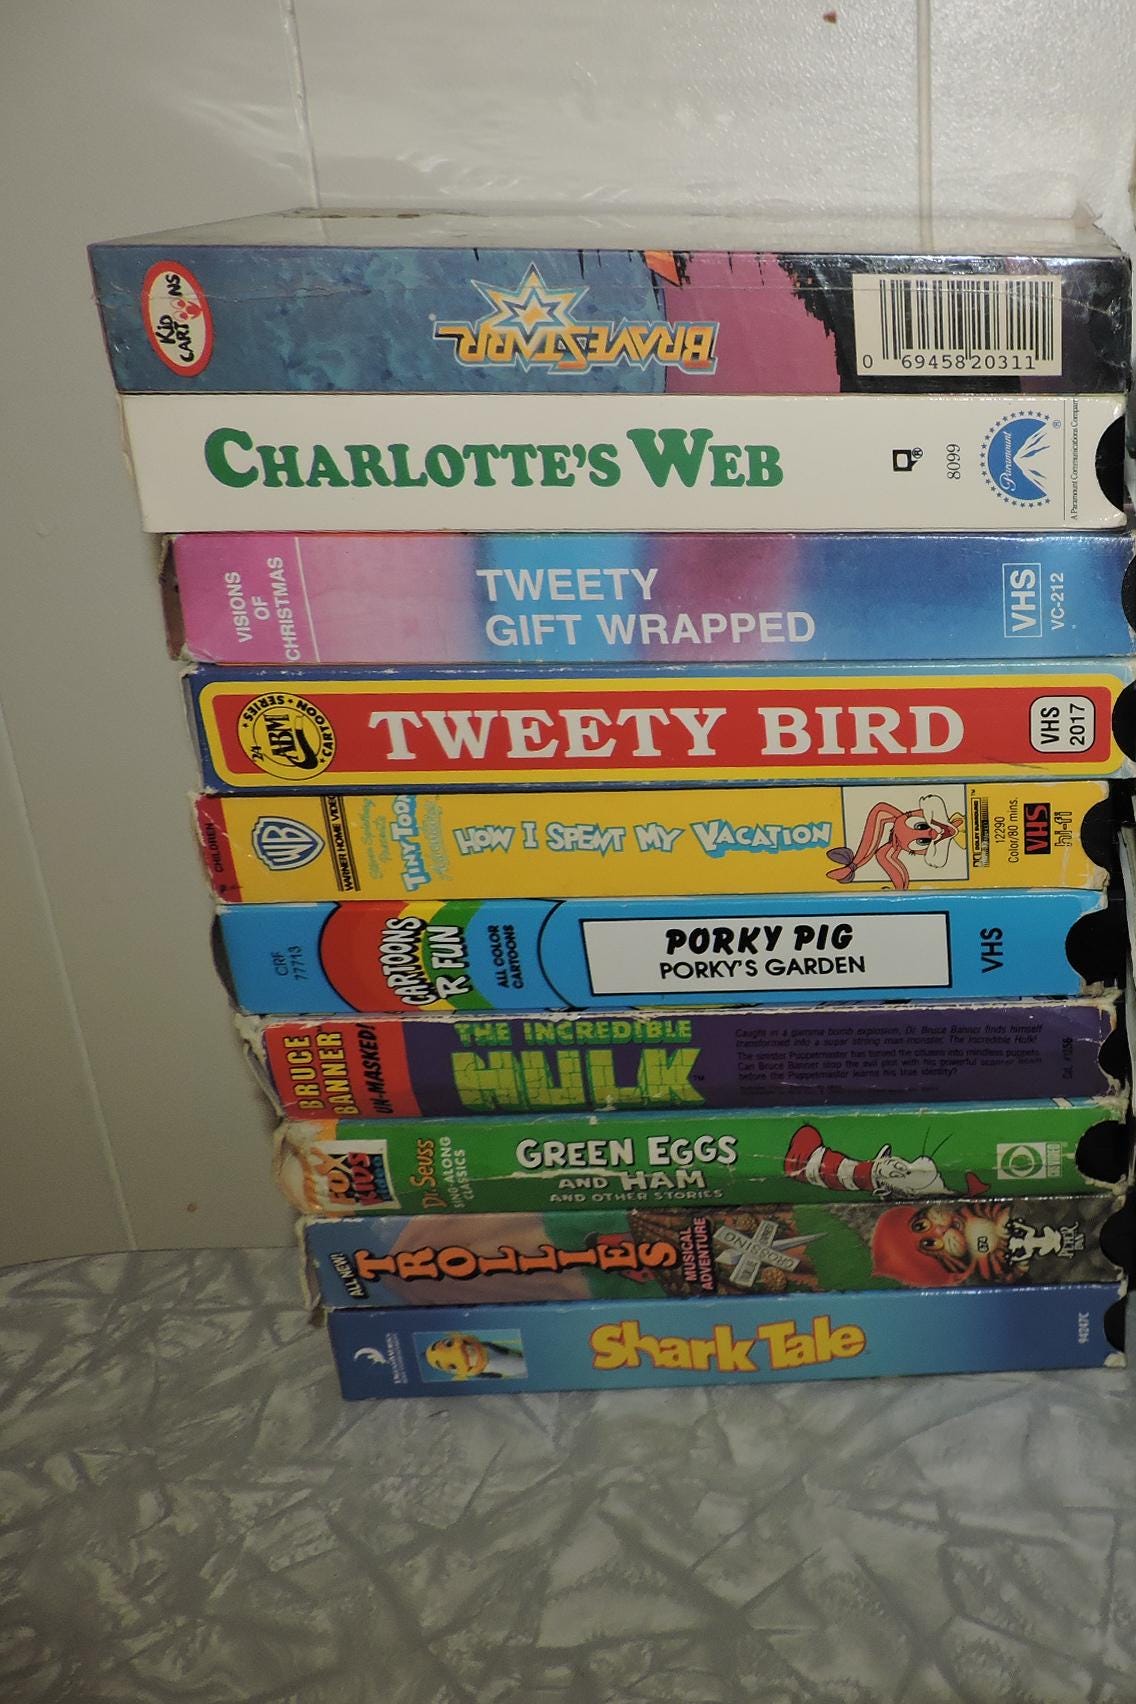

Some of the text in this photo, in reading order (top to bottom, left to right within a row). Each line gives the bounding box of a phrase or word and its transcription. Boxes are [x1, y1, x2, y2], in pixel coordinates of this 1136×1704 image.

[862, 354, 874, 369] 0
[203, 426, 784, 488] CHARLOTTE'S WEB
[946, 442, 961, 481] 8099
[998, 429, 1014, 492] Paramount
[1070, 427, 1079, 514] Paramount Communications
[223, 571, 254, 643] VISIONS
[254, 594, 271, 622] OF
[267, 556, 302, 662] CHRISTMAS
[476, 567, 659, 603] TWEETY
[1008, 568, 1037, 633] VHS
[1050, 571, 1065, 631] VC-212
[485, 610, 816, 647] GIFT WRAPPED
[243, 695, 334, 758] CARTOON SERIES
[368, 705, 966, 762] TWEETY BIRD
[1040, 706, 1060, 746] VHS
[1069, 702, 1087, 747] 2017
[206, 822, 225, 874] CHILDREN
[453, 822, 516, 858] HOW
[522, 821, 541, 849] I
[546, 821, 627, 856] SPENT
[632, 822, 682, 854] MY
[691, 818, 834, 859] VACATION
[994, 815, 1005, 844] 12290
[1007, 825, 1020, 864] Color/80
[1026, 804, 1049, 852] VHS
[1054, 811, 1073, 847] hi-fi
[332, 823, 356, 891] WARNER HOME
[401, 839, 432, 893] TINY
[275, 949, 288, 977] CRF
[379, 916, 438, 1006] CARTOONS
[426, 924, 470, 970] FUN
[487, 925, 510, 990] ALL COLOR
[502, 924, 525, 990] CARTOONS
[666, 922, 855, 956] PORKY PIG
[980, 926, 1004, 974] VHS
[435, 975, 473, 1000] R
[659, 954, 867, 981] PORKY'S GARDEN
[453, 1018, 693, 1046] THE INCREDIBLE
[284, 1034, 318, 1111] BRUCE
[317, 1031, 360, 1117] BANNER
[356, 1022, 394, 1115] UN-MASKED!
[451, 1047, 705, 1110] HULK
[438, 1136, 466, 1209] SING-ALONG
[453, 1148, 475, 1202] CLASSICS
[515, 1134, 738, 1169] GREEN EGGS
[547, 1188, 724, 1204] AND OTHER STORIES
[557, 1169, 707, 1191] AND HAM
[353, 1240, 679, 1284] TROLLIES
[680, 1227, 698, 1283] MUSICAL
[691, 1216, 714, 1291] ADVENTURE
[345, 1279, 365, 1297] ALL
[590, 1314, 868, 1373] Shark Tale
